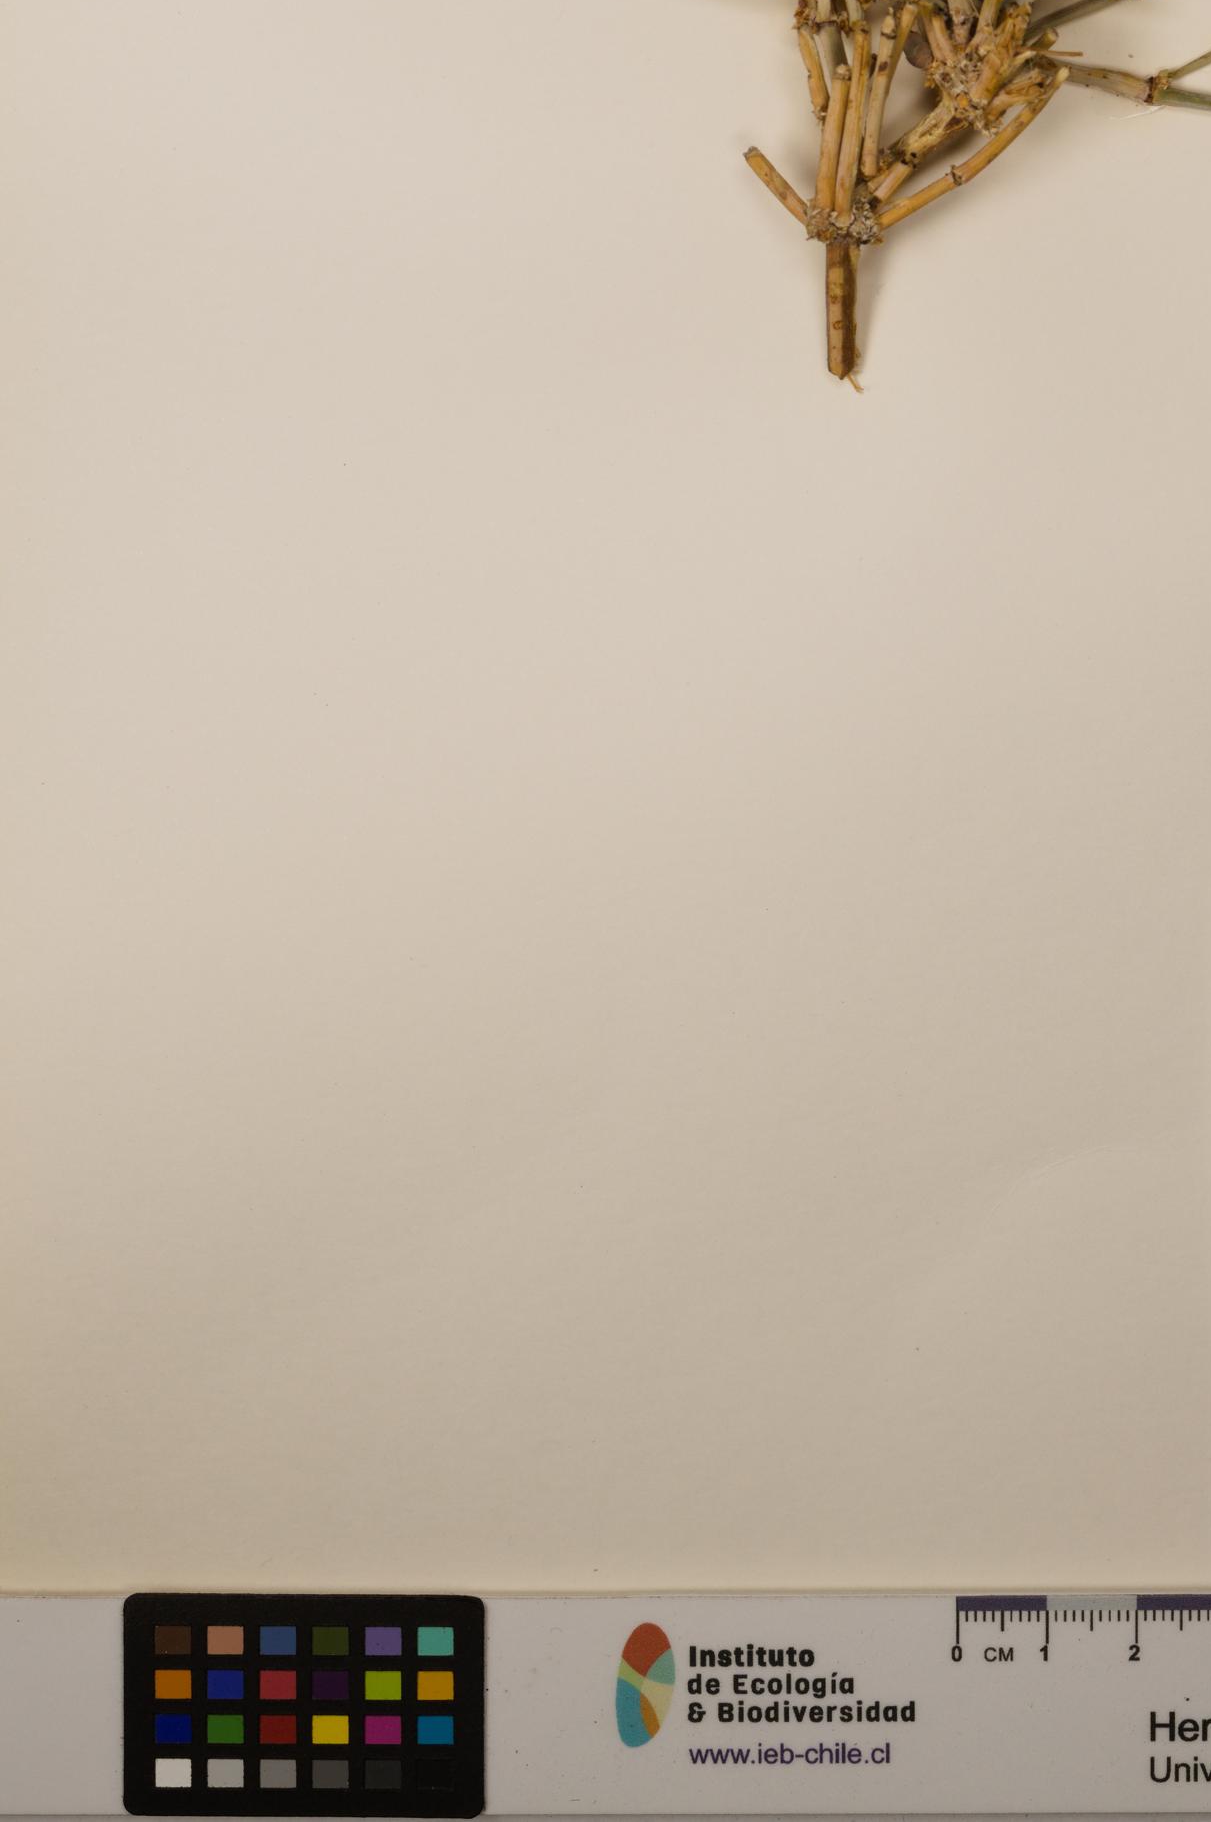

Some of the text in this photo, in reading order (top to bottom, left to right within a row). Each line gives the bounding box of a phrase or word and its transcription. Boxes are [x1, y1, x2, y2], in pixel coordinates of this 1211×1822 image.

[688, 1644, 815, 1669] Instituto
[951, 1643, 963, 1663] 0
[983, 1646, 1014, 1663] CM
[1038, 1643, 1049, 1662] 1
[1128, 1643, 1141, 1662] 2
[687, 1671, 855, 1700] de Ecología
[687, 1700, 916, 1725] & Biodiversidad
[688, 1742, 891, 1766] www.ieb-chile.cl
